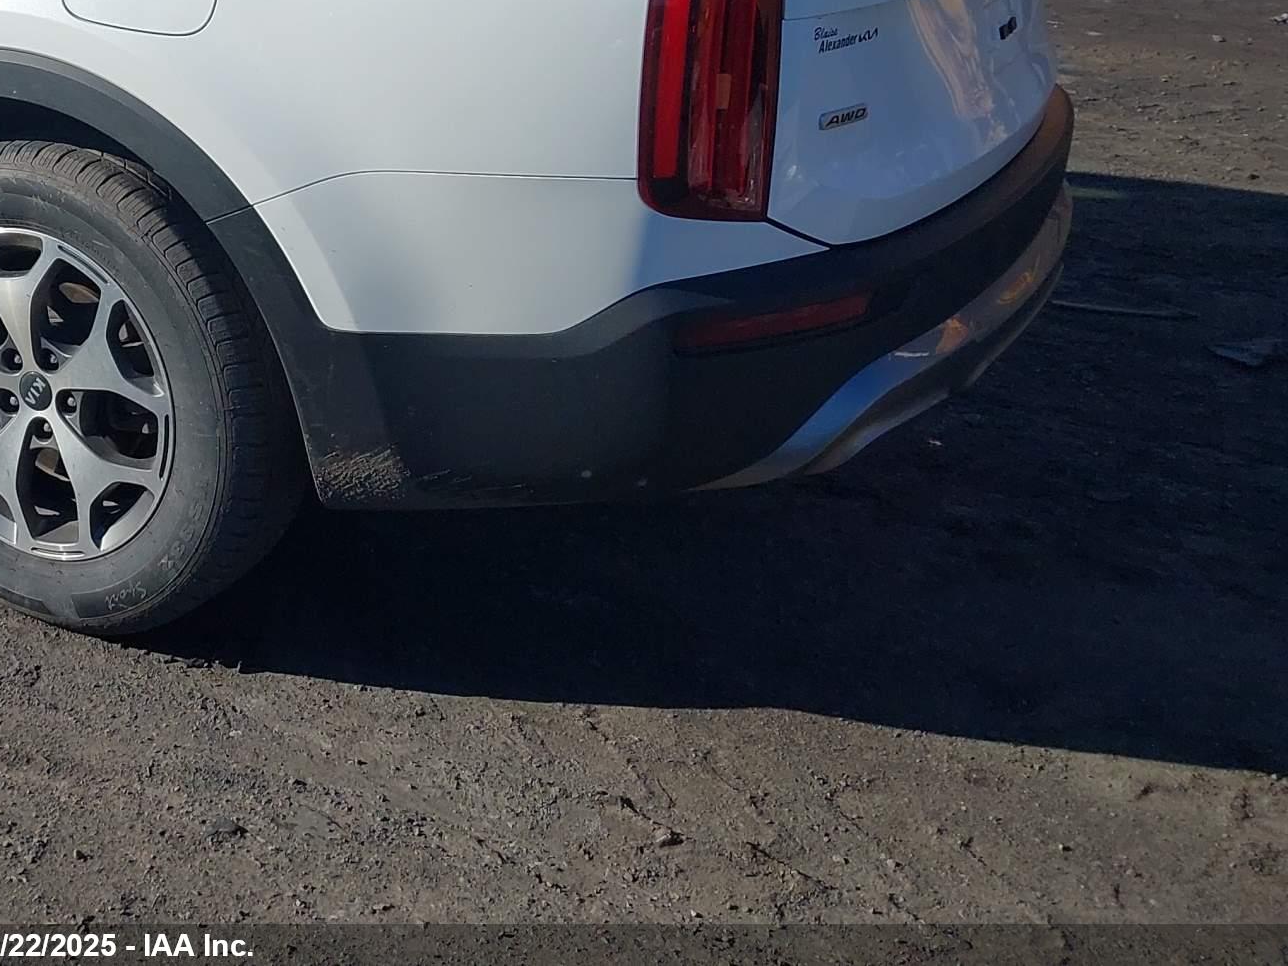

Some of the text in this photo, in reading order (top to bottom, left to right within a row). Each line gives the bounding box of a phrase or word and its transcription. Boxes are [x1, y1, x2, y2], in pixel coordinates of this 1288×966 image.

[818, 33, 858, 54] Alexander
[825, 107, 867, 127] AWD
[25, 377, 46, 405] KIA
[104, 580, 148, 612] Sport
